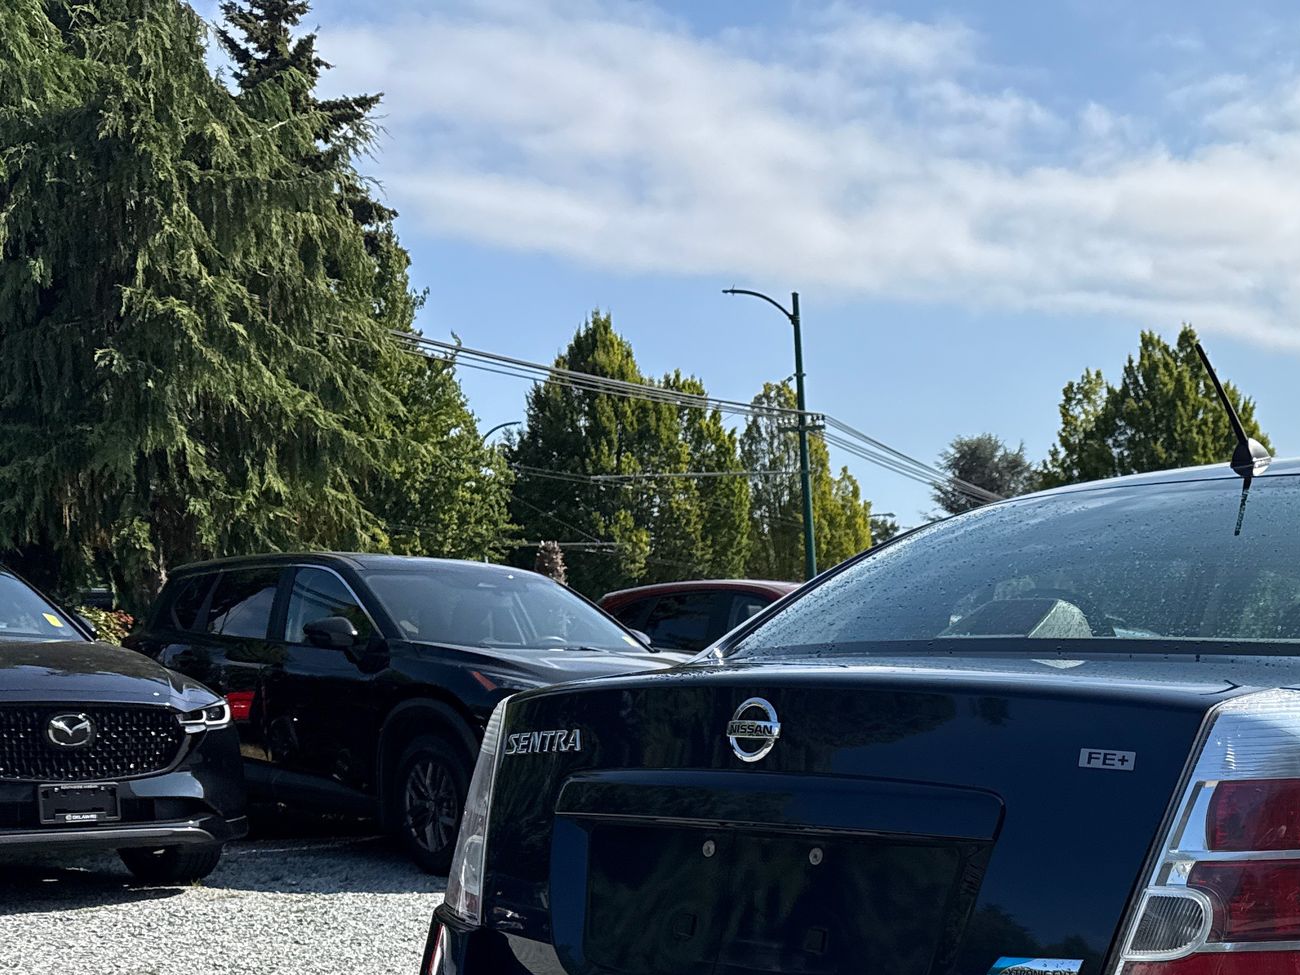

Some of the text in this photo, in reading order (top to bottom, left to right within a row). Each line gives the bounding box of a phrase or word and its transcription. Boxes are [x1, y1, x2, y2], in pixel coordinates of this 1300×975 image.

[730, 723, 774, 735] NISSAN
[505, 728, 582, 755] SENTRA
[1087, 751, 1129, 767] FE+
